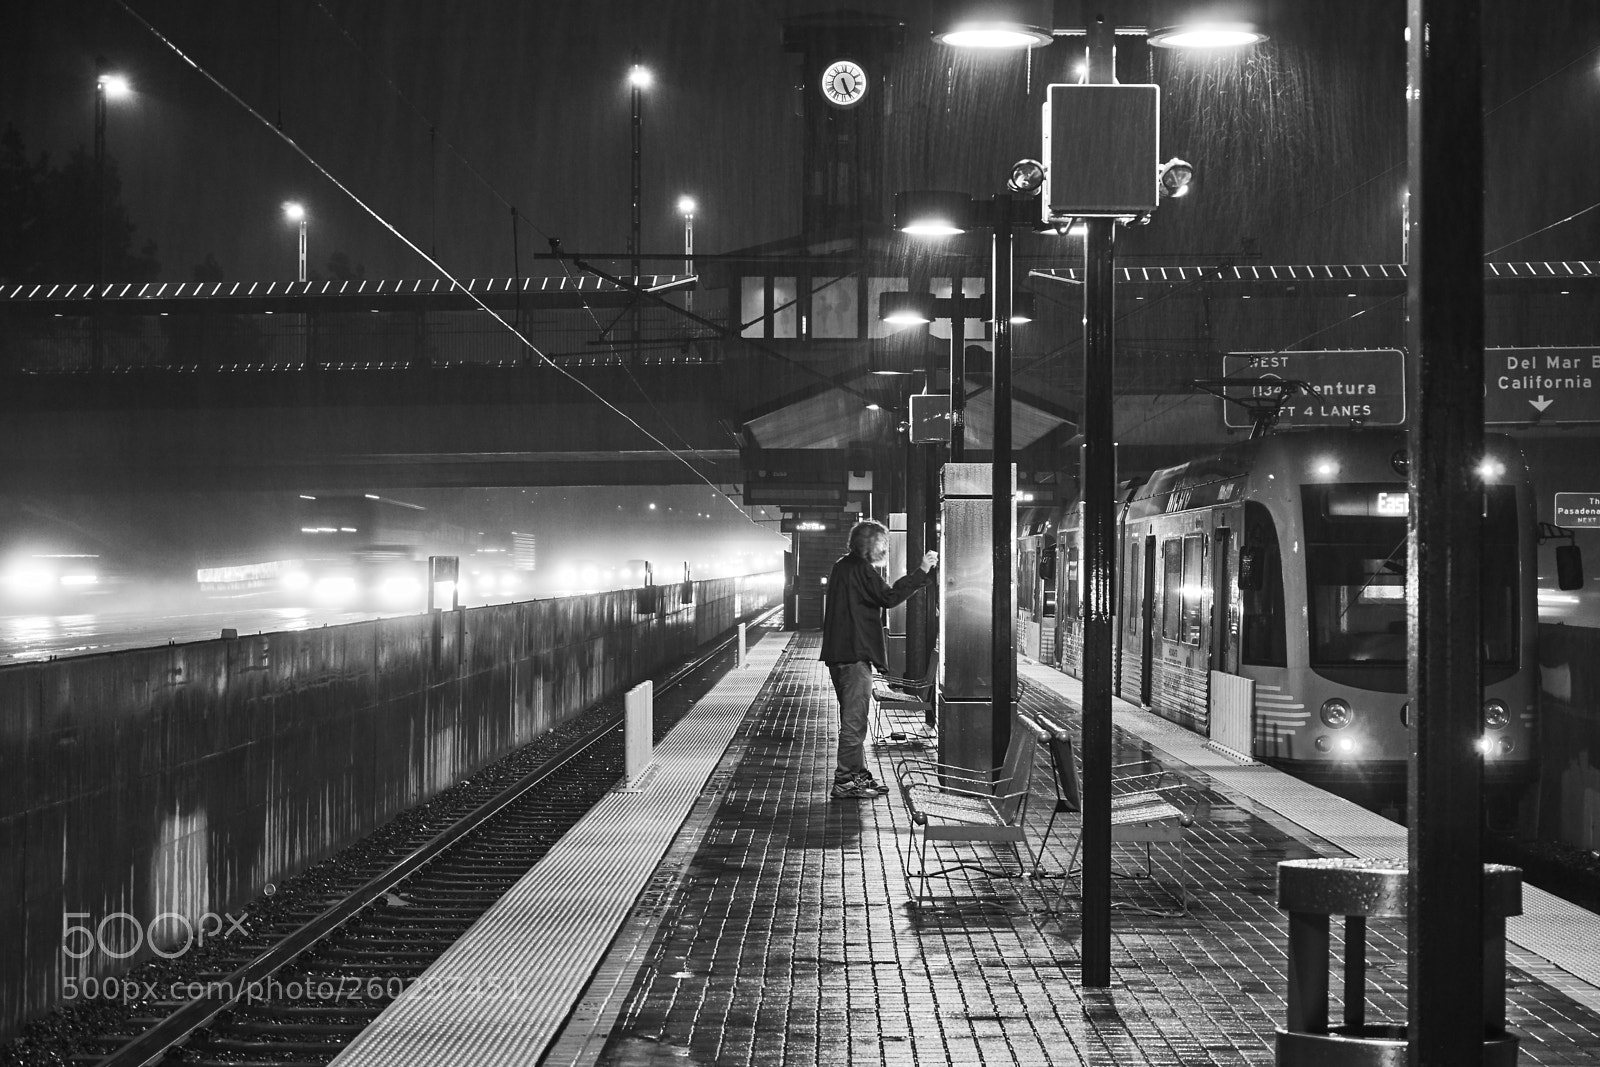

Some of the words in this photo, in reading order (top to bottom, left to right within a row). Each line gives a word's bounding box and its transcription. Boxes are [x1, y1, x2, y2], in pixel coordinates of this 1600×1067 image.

[1507, 356, 1536, 370] Del
[1546, 356, 1581, 369] Mar
[1498, 375, 1592, 390] California
[1303, 406, 1314, 417] 4
[1321, 405, 1372, 417] LANES
[1557, 507, 1600, 515] Pasadena
